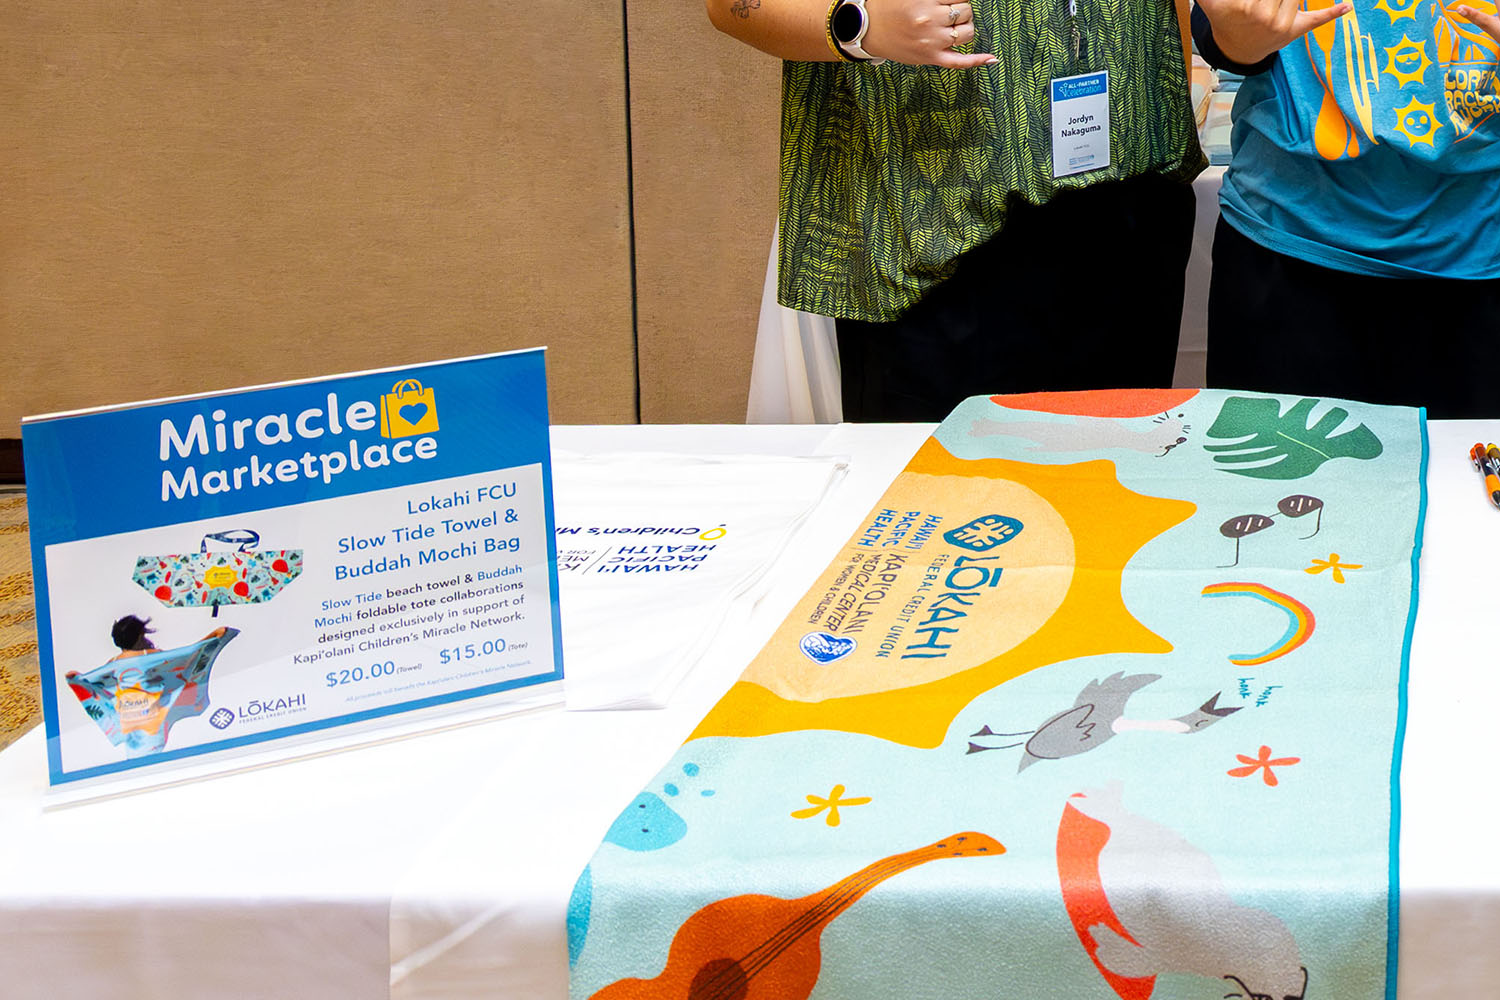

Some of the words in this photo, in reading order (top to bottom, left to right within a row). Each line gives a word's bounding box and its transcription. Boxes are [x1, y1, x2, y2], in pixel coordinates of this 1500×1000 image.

[1061, 124, 1101, 137] Nakaguma
[1068, 114, 1094, 125] Jordyn
[160, 393, 376, 461] Miracle
[161, 437, 438, 501] Marketplace
[407, 490, 470, 515] Lokahi
[477, 482, 517, 502] FCU
[338, 533, 386, 553] Slow
[392, 524, 436, 544] Tide
[441, 511, 497, 534] Towel
[504, 508, 518, 523] &
[587, 527, 700, 536] Children's
[857, 508, 899, 548] HEALTH
[881, 511, 921, 547] PACIFIC
[905, 514, 944, 550] HAWAI'I
[335, 555, 411, 580] Buddah
[418, 541, 477, 565] Mochi
[484, 536, 520, 553] Bag
[608, 554, 708, 564] PACIFIC
[618, 544, 717, 555] HEALTH
[597, 563, 699, 574] HAWAI'I
[834, 564, 857, 587] WOMEN
[847, 554, 883, 593] MEDICAL
[916, 554, 950, 593] FEDERAL
[314, 612, 352, 628] Mochi
[356, 601, 407, 620] foldable
[411, 597, 436, 610] tote
[440, 580, 524, 604] collaborations
[321, 598, 352, 611] Slow
[355, 591, 383, 604] Tide
[386, 583, 423, 599] beach
[427, 575, 460, 591] towel
[464, 573, 474, 584] &
[477, 564, 522, 581] Buddah
[842, 553, 909, 634] KAPI'OLANI
[318, 623, 375, 644] designed
[379, 610, 444, 632] exclusively
[448, 608, 459, 618] in
[462, 600, 508, 618] support
[512, 594, 525, 606] of
[807, 592, 837, 625] CHILDREN
[823, 593, 857, 632] CENTER
[901, 555, 1003, 659] LŌKAHI
[903, 595, 926, 623] CREDIT
[293, 644, 355, 665] Kapi'olani
[358, 632, 419, 652] Children's
[423, 622, 466, 640] Miracle
[470, 612, 525, 630] Network.
[439, 638, 506, 665] $15.00
[875, 625, 905, 658] UNION
[325, 660, 395, 688] $20.00
[239, 693, 305, 718] LŌKAHI
